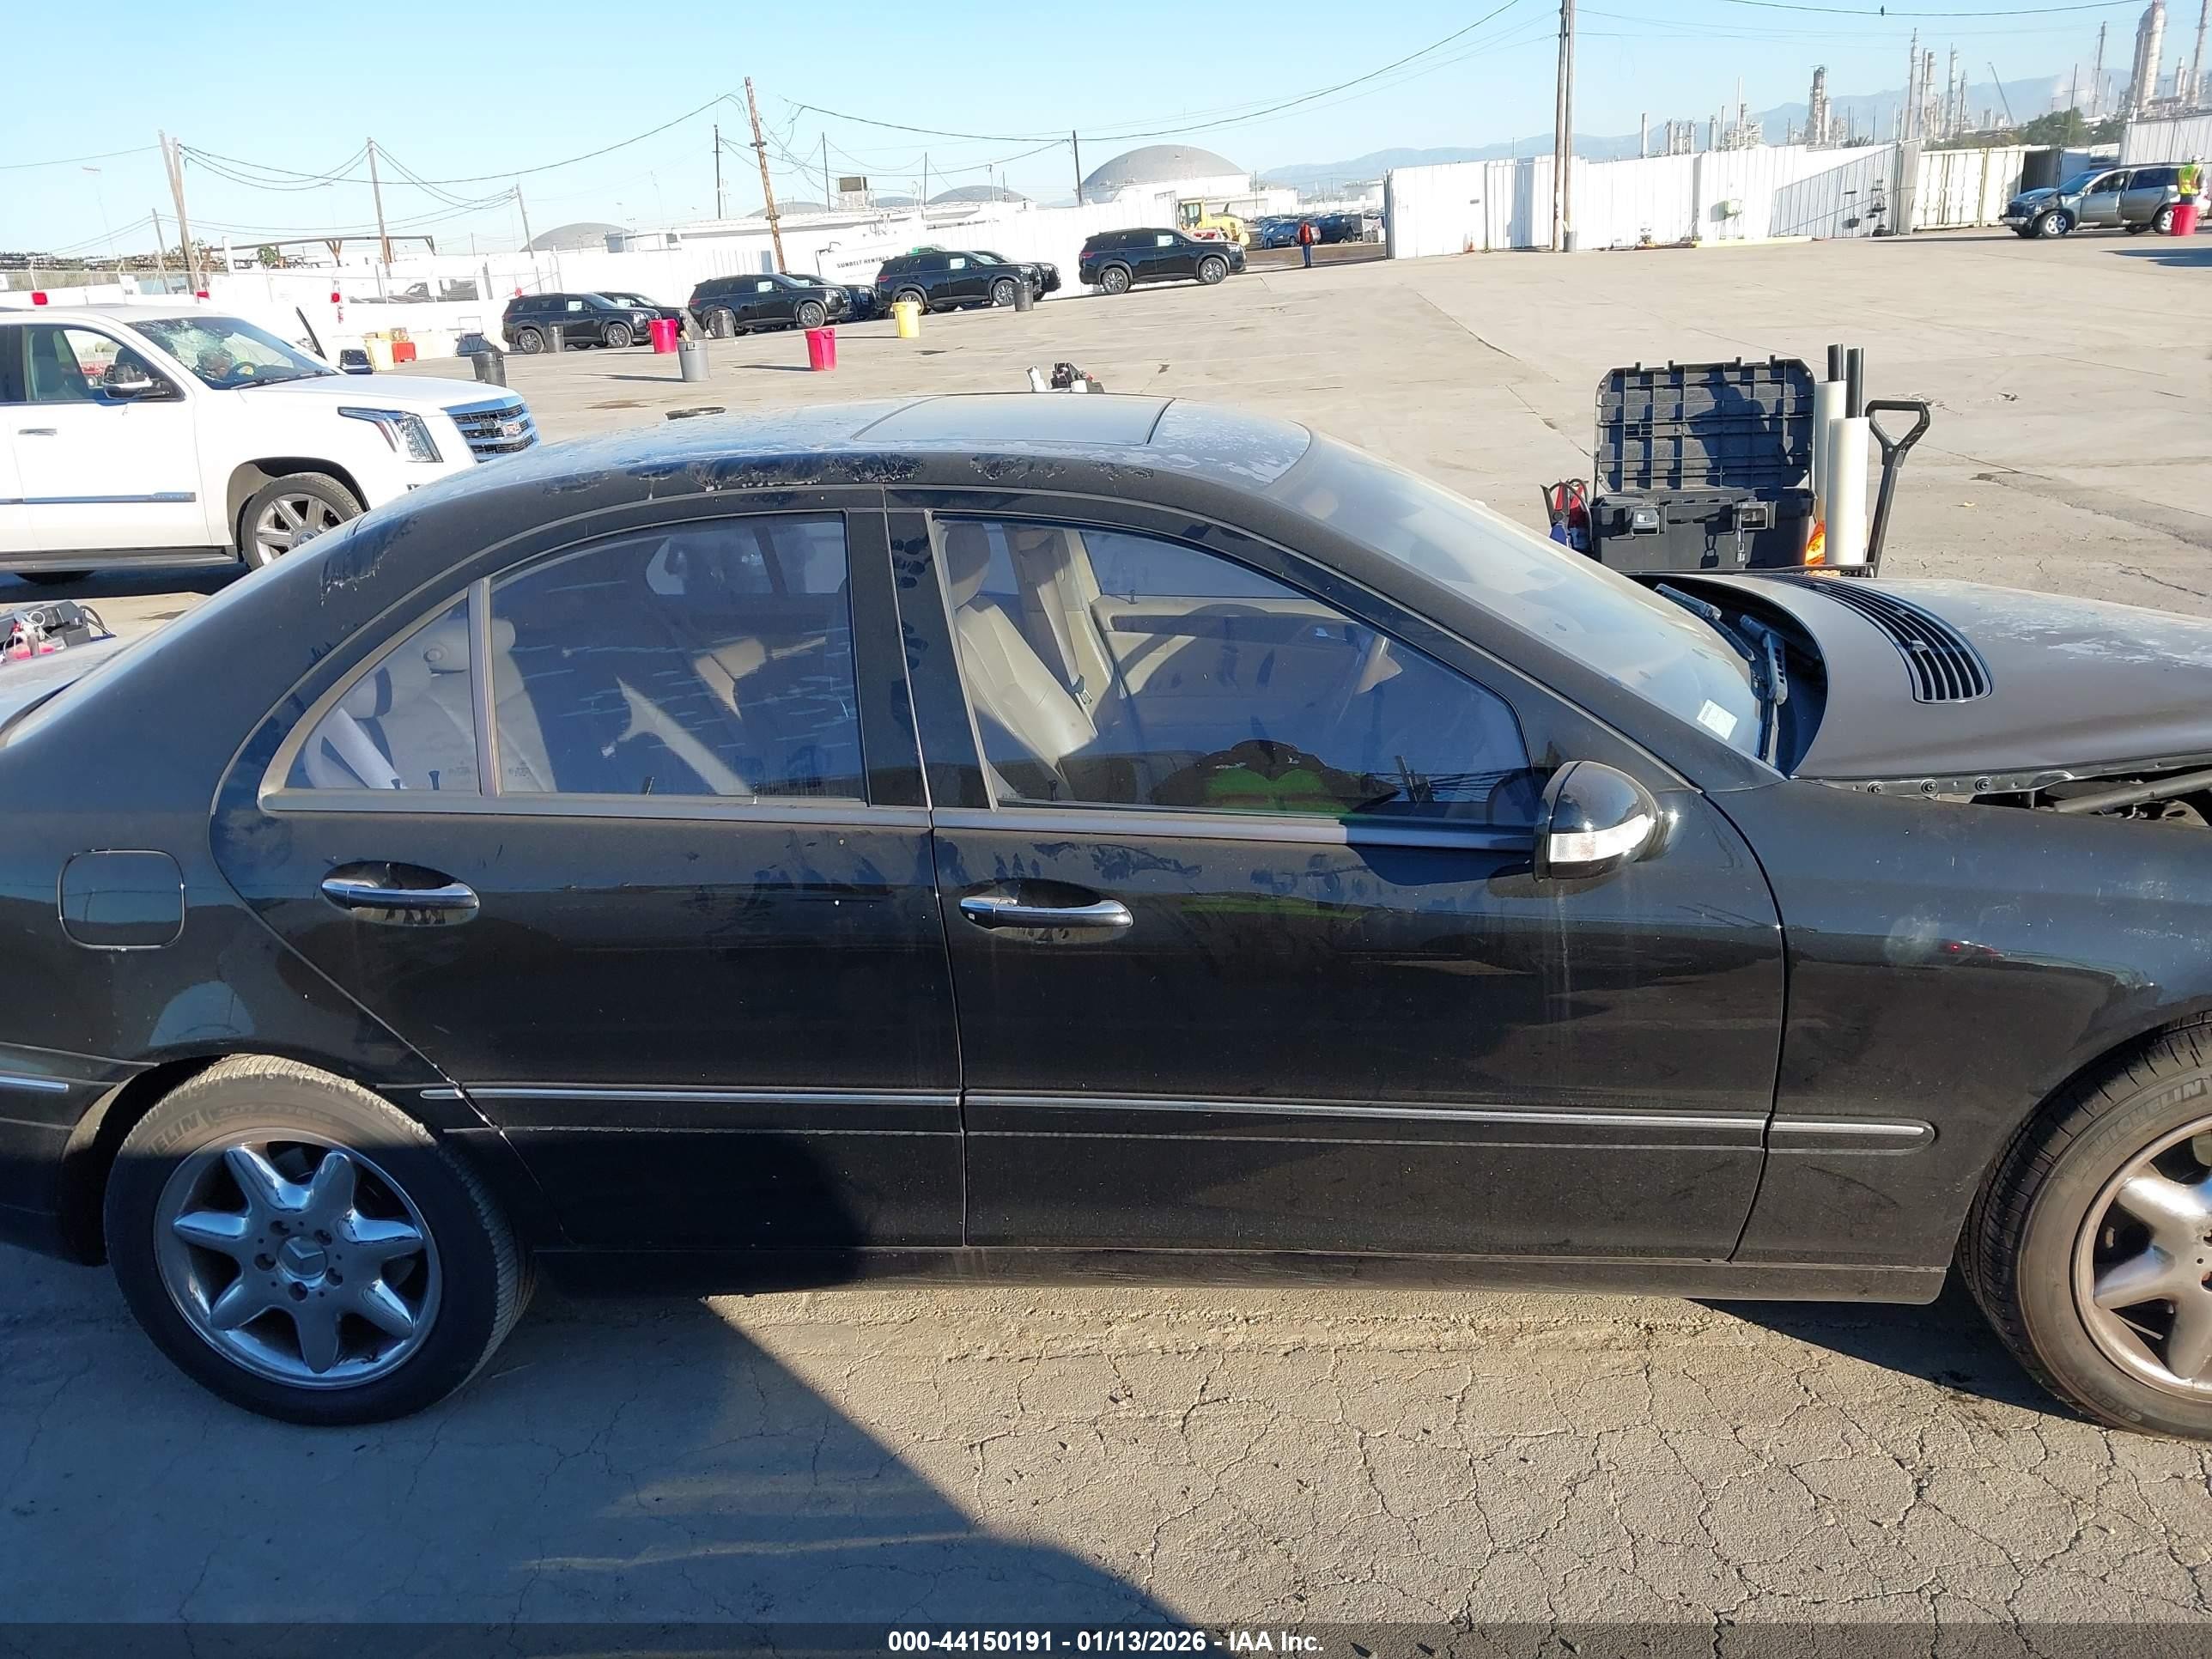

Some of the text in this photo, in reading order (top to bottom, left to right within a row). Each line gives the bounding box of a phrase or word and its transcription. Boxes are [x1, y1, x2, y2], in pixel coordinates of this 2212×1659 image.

[836, 259, 863, 269] SUNBELT
[2094, 1079, 2204, 1156] MICHELIN
[2066, 1372, 2143, 1423] ENERGY
